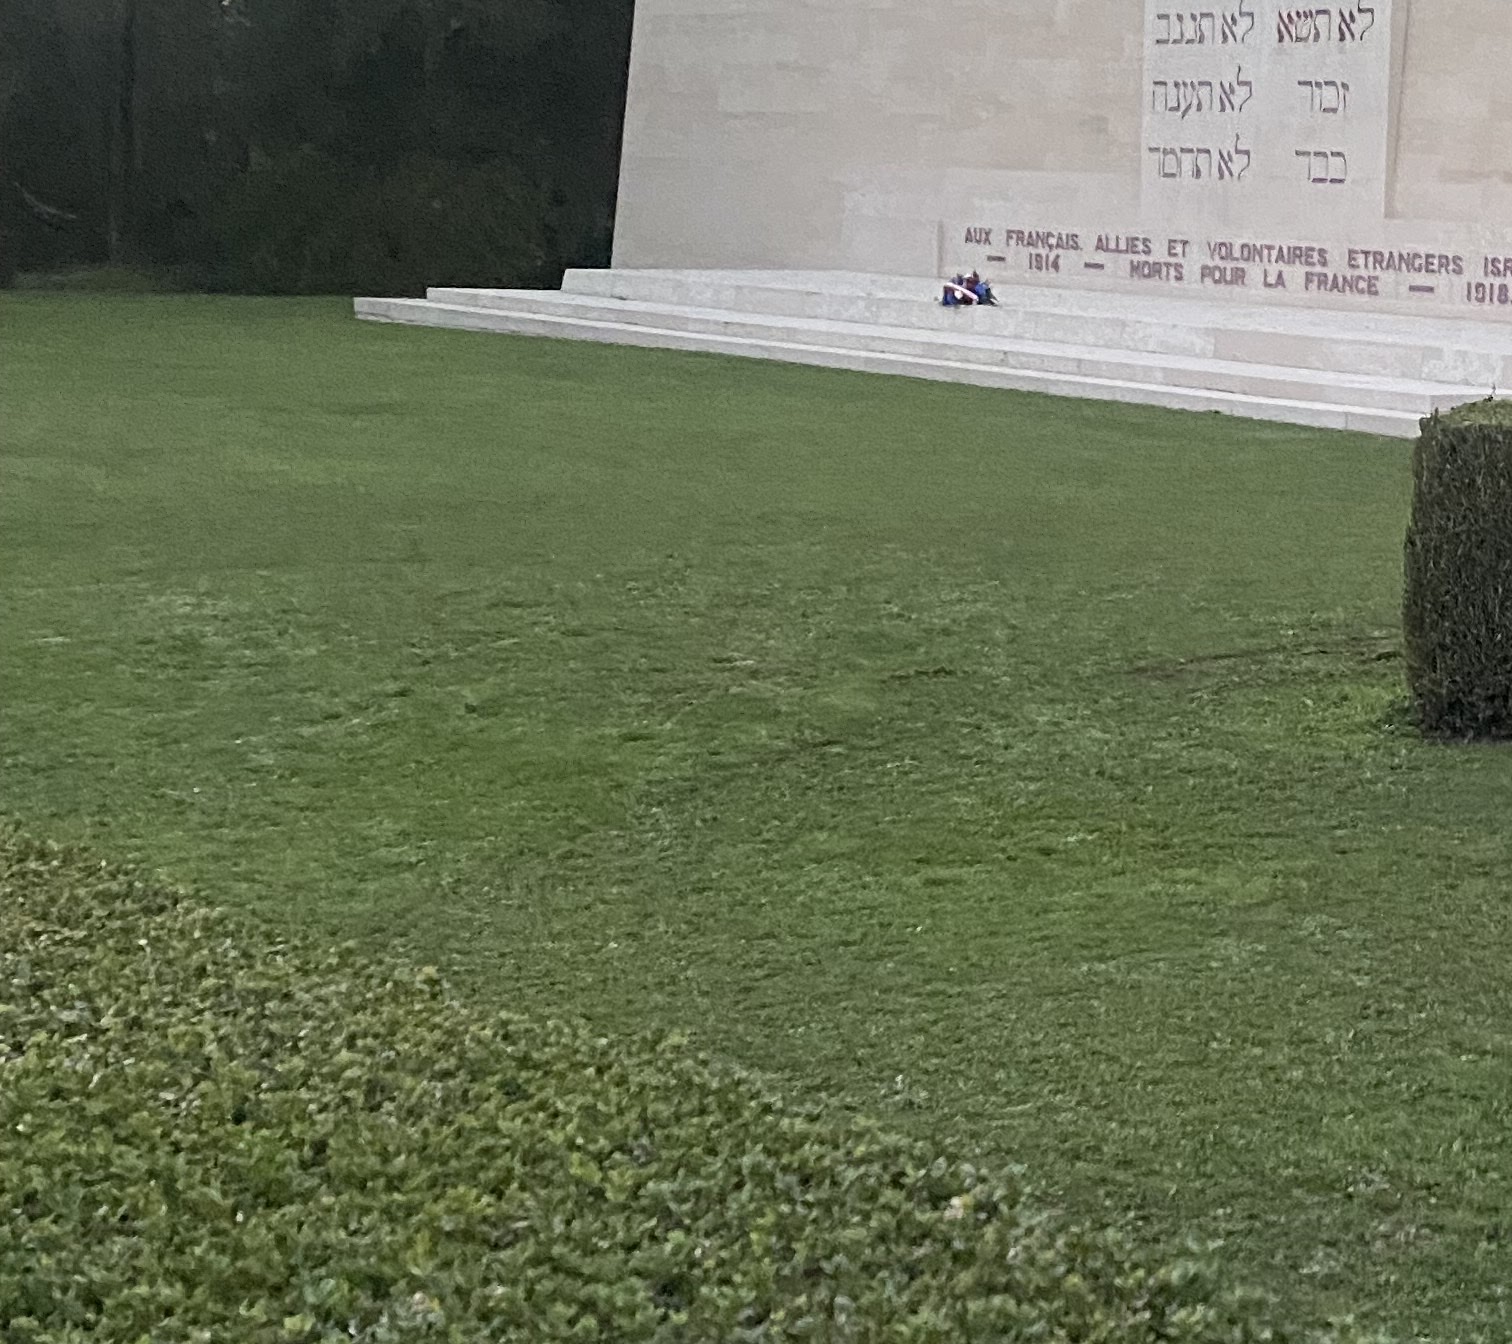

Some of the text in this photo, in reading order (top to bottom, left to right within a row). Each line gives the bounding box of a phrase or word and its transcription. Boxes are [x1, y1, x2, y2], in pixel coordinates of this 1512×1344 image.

[1277, 8, 1331, 43] תשא
[1152, 64, 1252, 119] לא תענה
[1297, 80, 1350, 113] זכור
[1217, 132, 1250, 182] לא
[964, 227, 993, 246] AUX
[1094, 234, 1152, 256] ALLIES
[1167, 238, 1190, 257] ET
[1207, 241, 1329, 268] VOLONTAIRES
[1347, 247, 1464, 275] ETRANGERS
[1028, 252, 1060, 273] 1914
[1128, 259, 1184, 282] MORTS
[1200, 264, 1247, 286] POUR
[1263, 268, 1286, 289] LA
[1304, 271, 1379, 296] FRANCE
